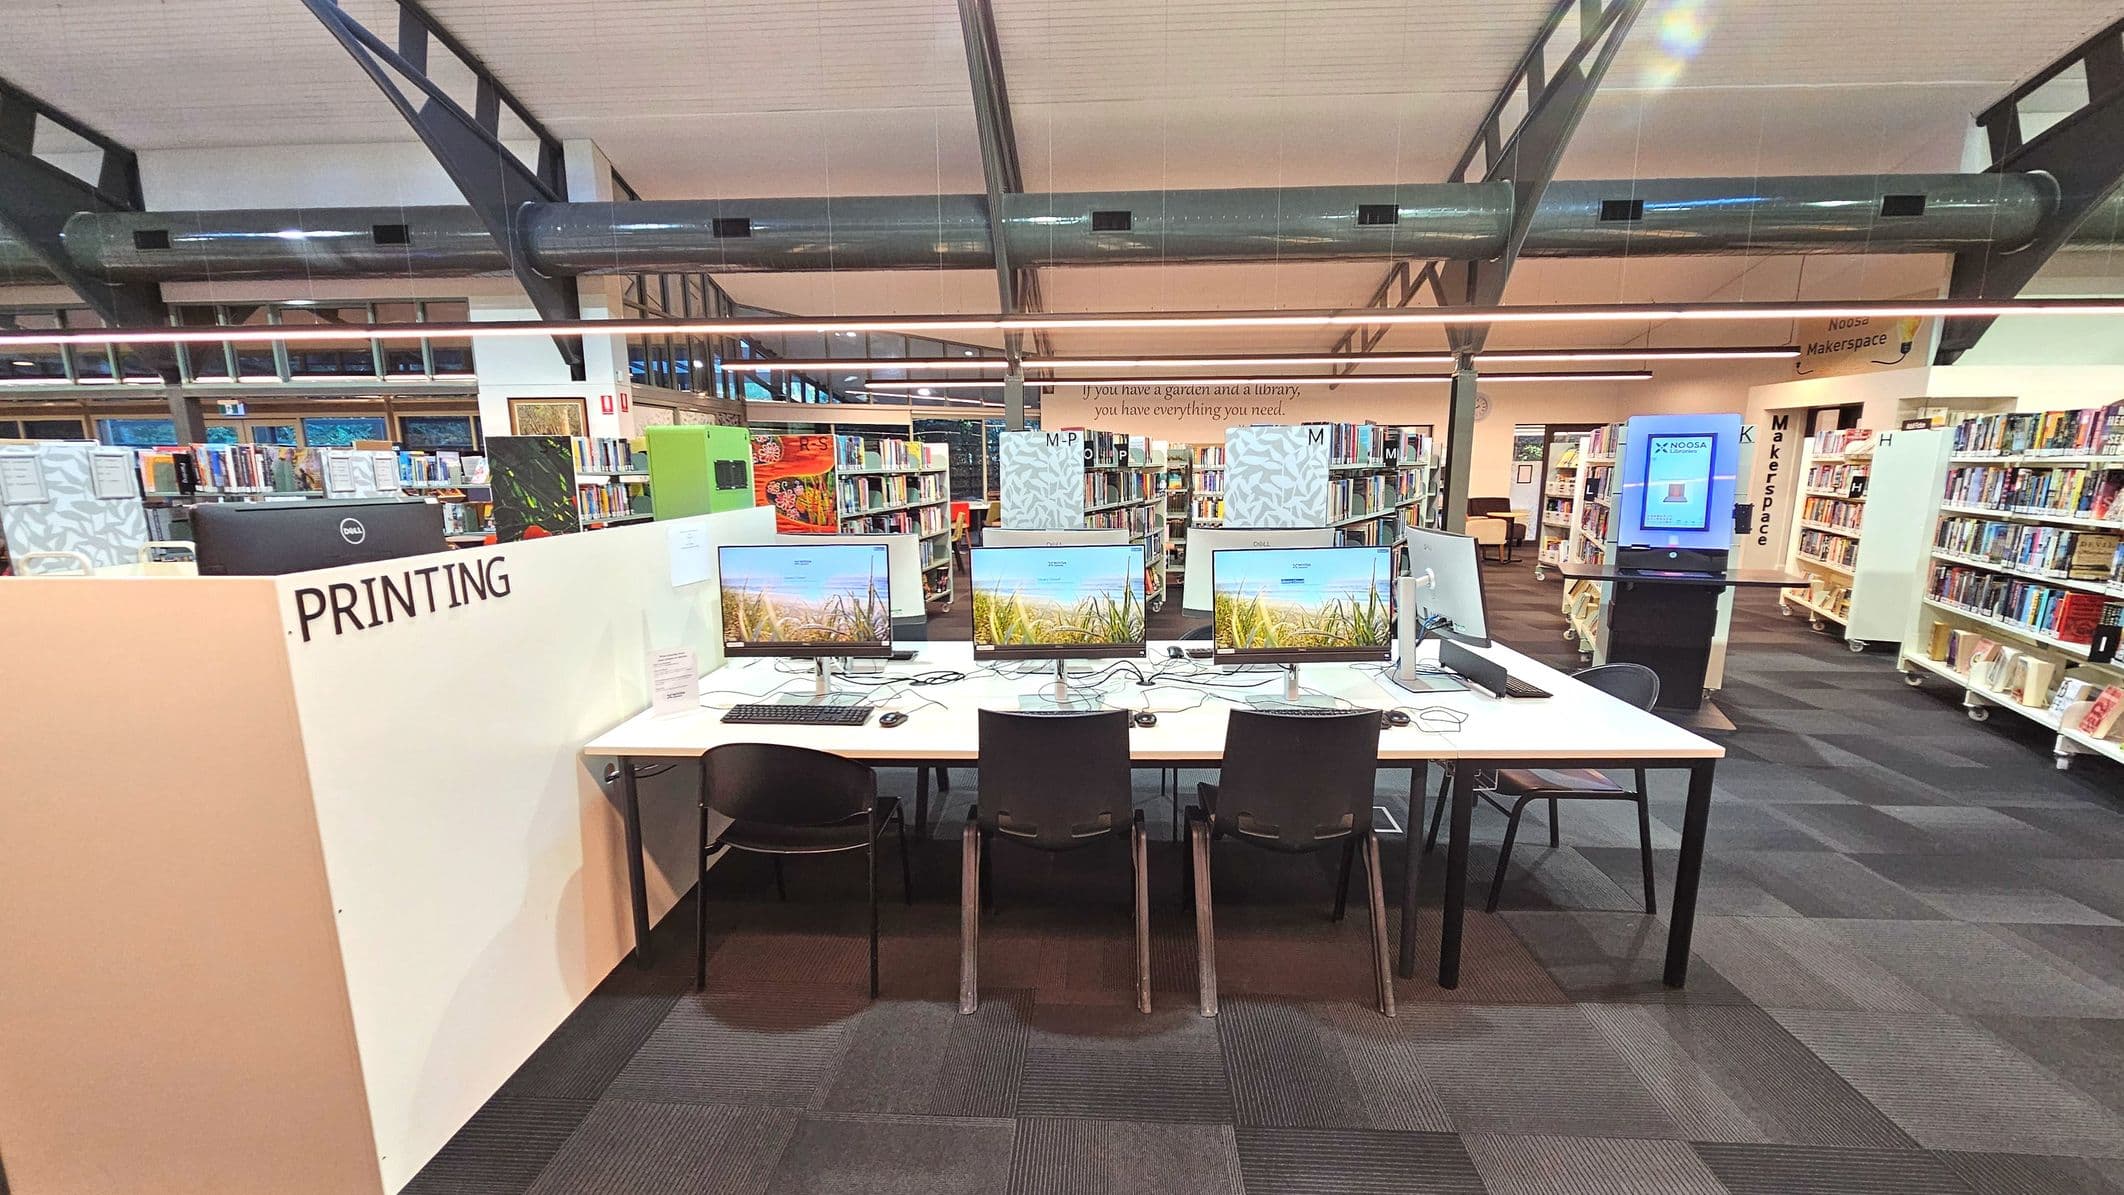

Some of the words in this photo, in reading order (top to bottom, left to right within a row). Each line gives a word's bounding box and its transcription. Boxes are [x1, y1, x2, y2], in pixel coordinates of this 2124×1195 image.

[1828, 316, 1870, 331] Noosa
[1807, 333, 1887, 355] Makerspace
[1094, 387, 1118, 400] you
[1121, 384, 1150, 396] have
[1153, 387, 1162, 396] a
[1164, 384, 1210, 400] garden
[1214, 384, 1240, 396] and
[1243, 387, 1251, 396] a
[1255, 384, 1301, 398] library,
[1094, 404, 1117, 420] you
[1121, 400, 1150, 416] have
[1153, 400, 1221, 420] everything
[1223, 404, 1248, 420] you
[1251, 401, 1286, 416] need.
[1308, 428, 1324, 446] M
[1740, 426, 1754, 443] K
[1879, 433, 1893, 447] H
[1084, 448, 1093, 460] O
[1119, 450, 1127, 461] P
[1386, 448, 1397, 459] M
[1758, 414, 1789, 546] Makerspace
[1586, 485, 1594, 495] L
[1851, 483, 1863, 493] H
[343, 527, 363, 535] DELL
[295, 556, 511, 642] PRINTING
